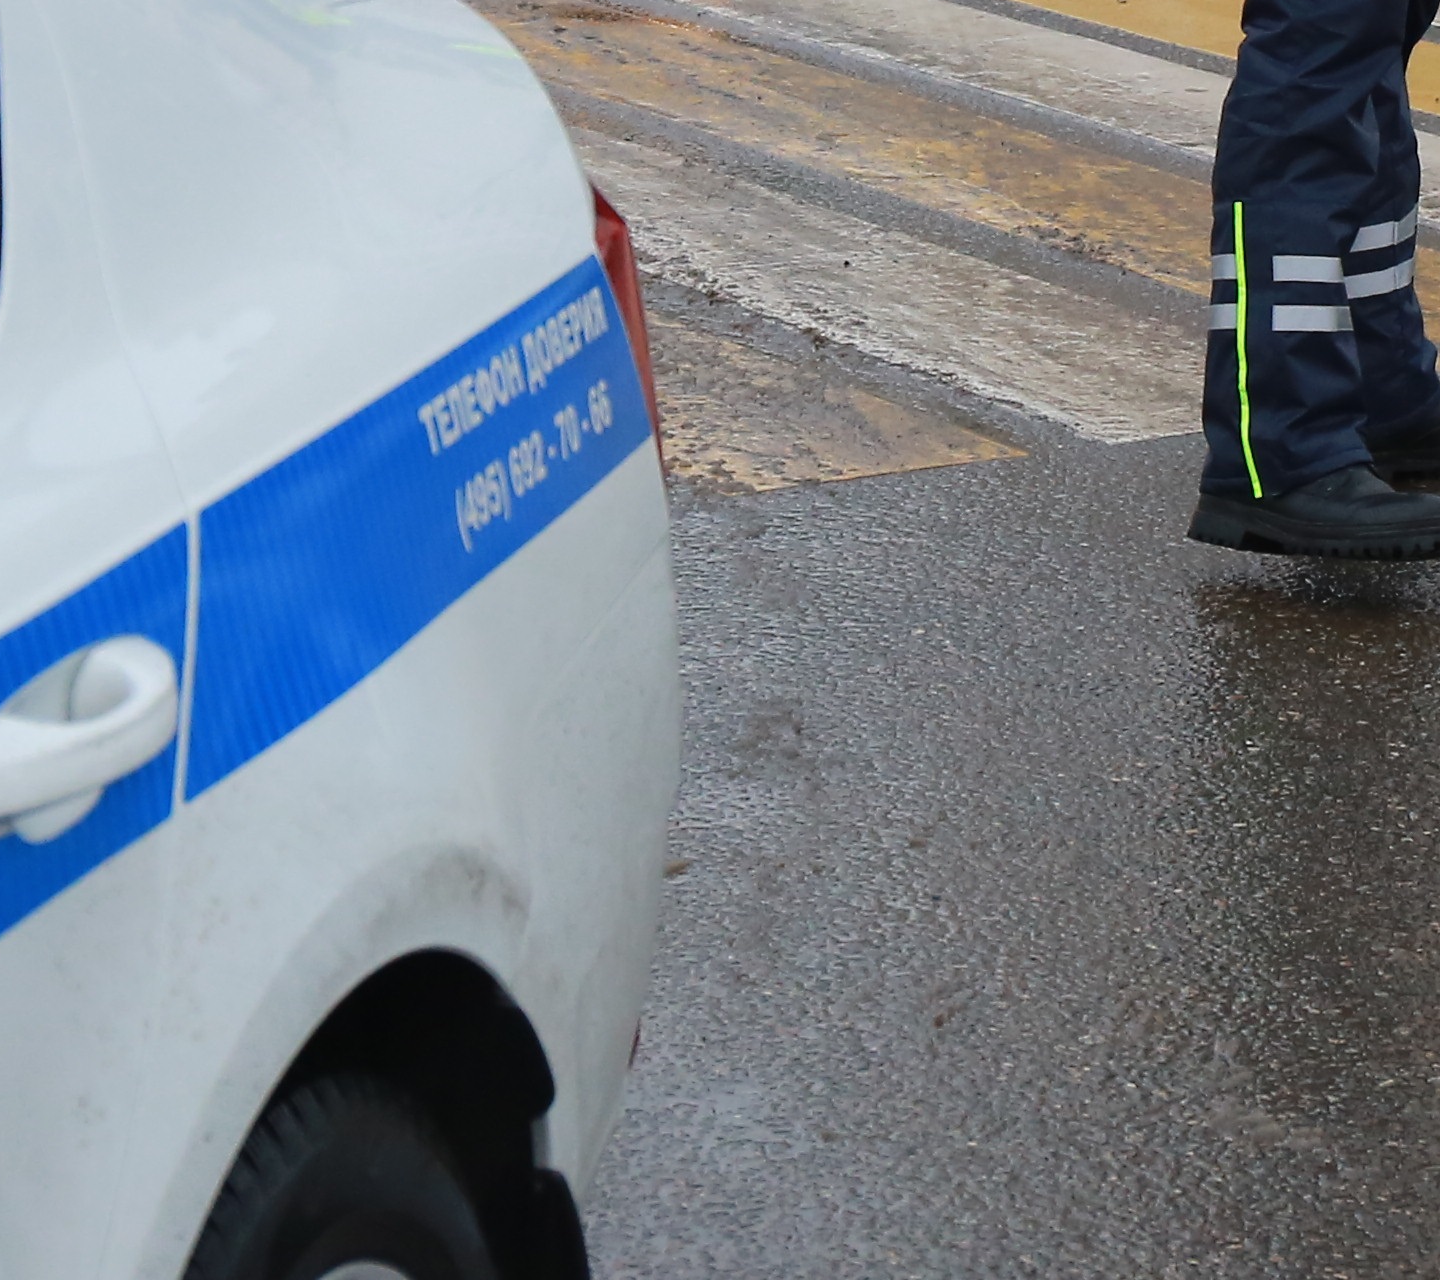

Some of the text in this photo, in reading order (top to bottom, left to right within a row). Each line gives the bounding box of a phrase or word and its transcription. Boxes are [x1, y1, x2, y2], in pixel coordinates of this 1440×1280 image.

[417, 286, 609, 457] ТЕЛЕФОН ДОВЕРИЯ
[455, 457, 511, 554] (495)
